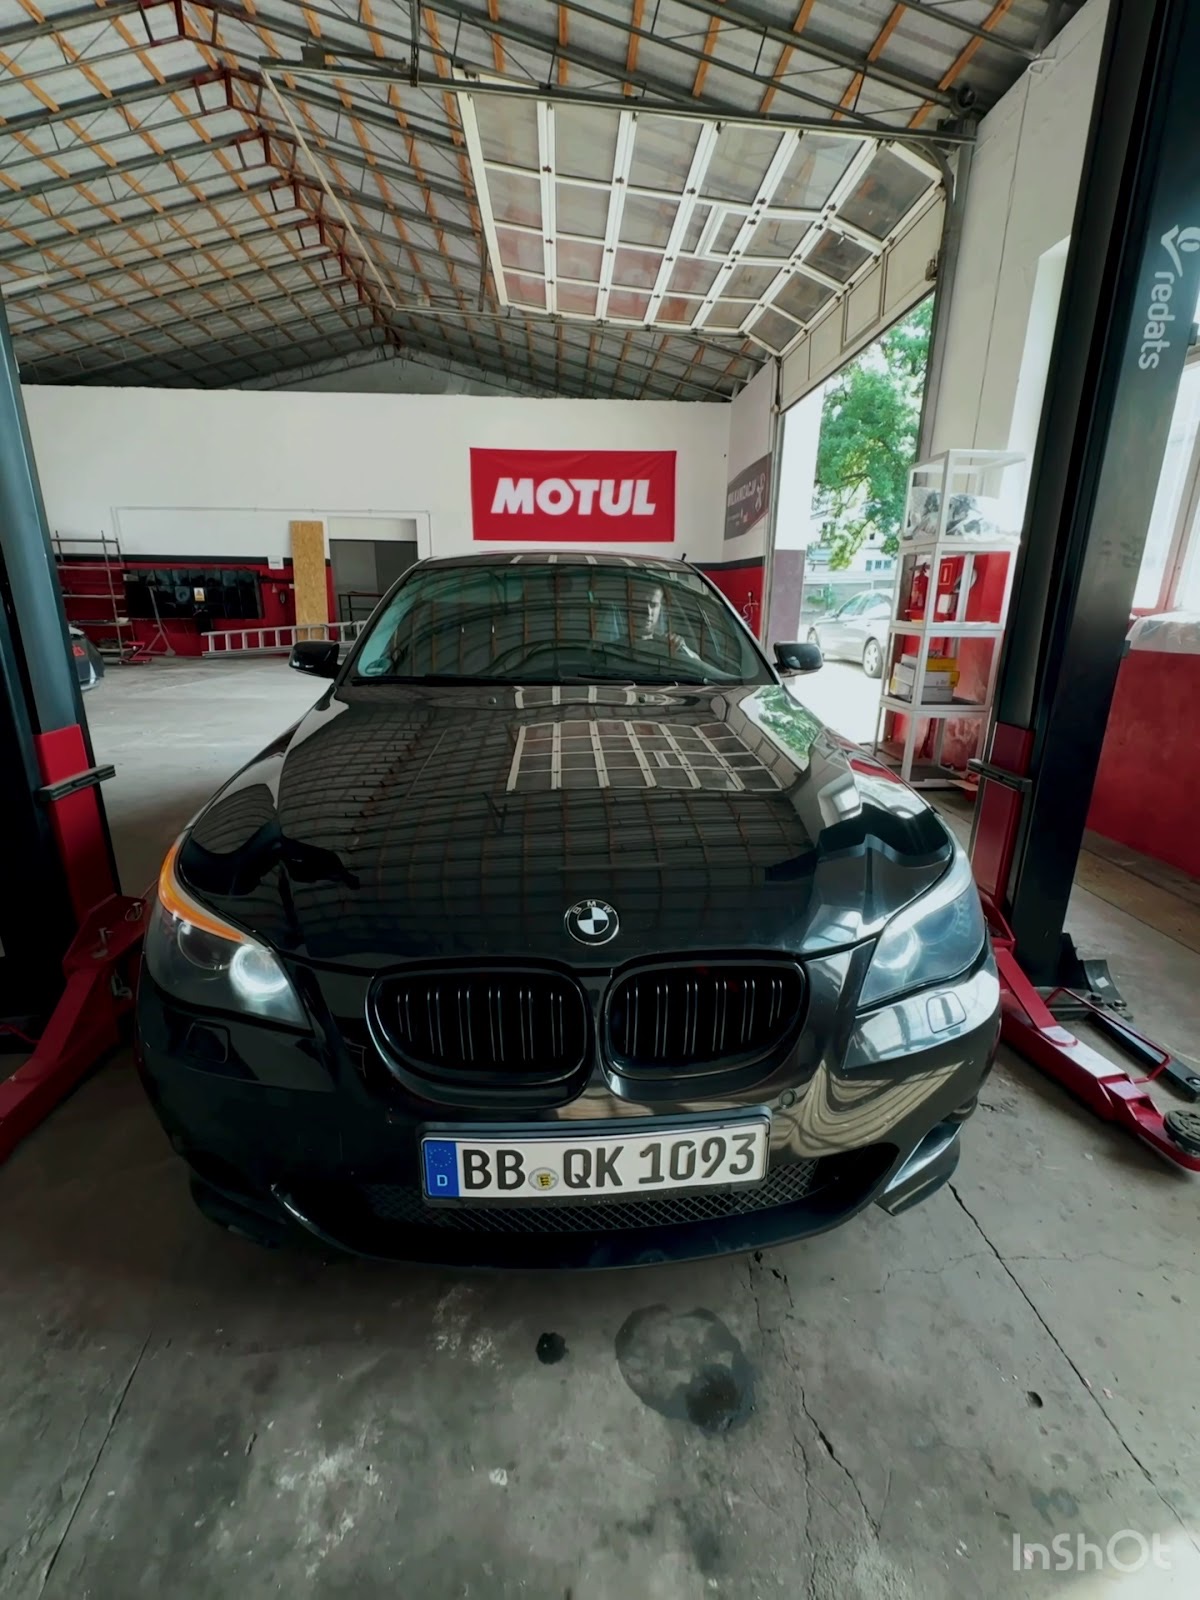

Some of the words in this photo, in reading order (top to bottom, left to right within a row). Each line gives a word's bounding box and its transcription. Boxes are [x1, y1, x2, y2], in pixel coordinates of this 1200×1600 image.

[1138, 271, 1176, 370] redats
[490, 477, 656, 516] MOTUL
[572, 900, 613, 915] BMW
[436, 1174, 449, 1187] D
[462, 1149, 526, 1191] BB
[563, 1146, 625, 1189] QK
[638, 1132, 757, 1185] 1093
